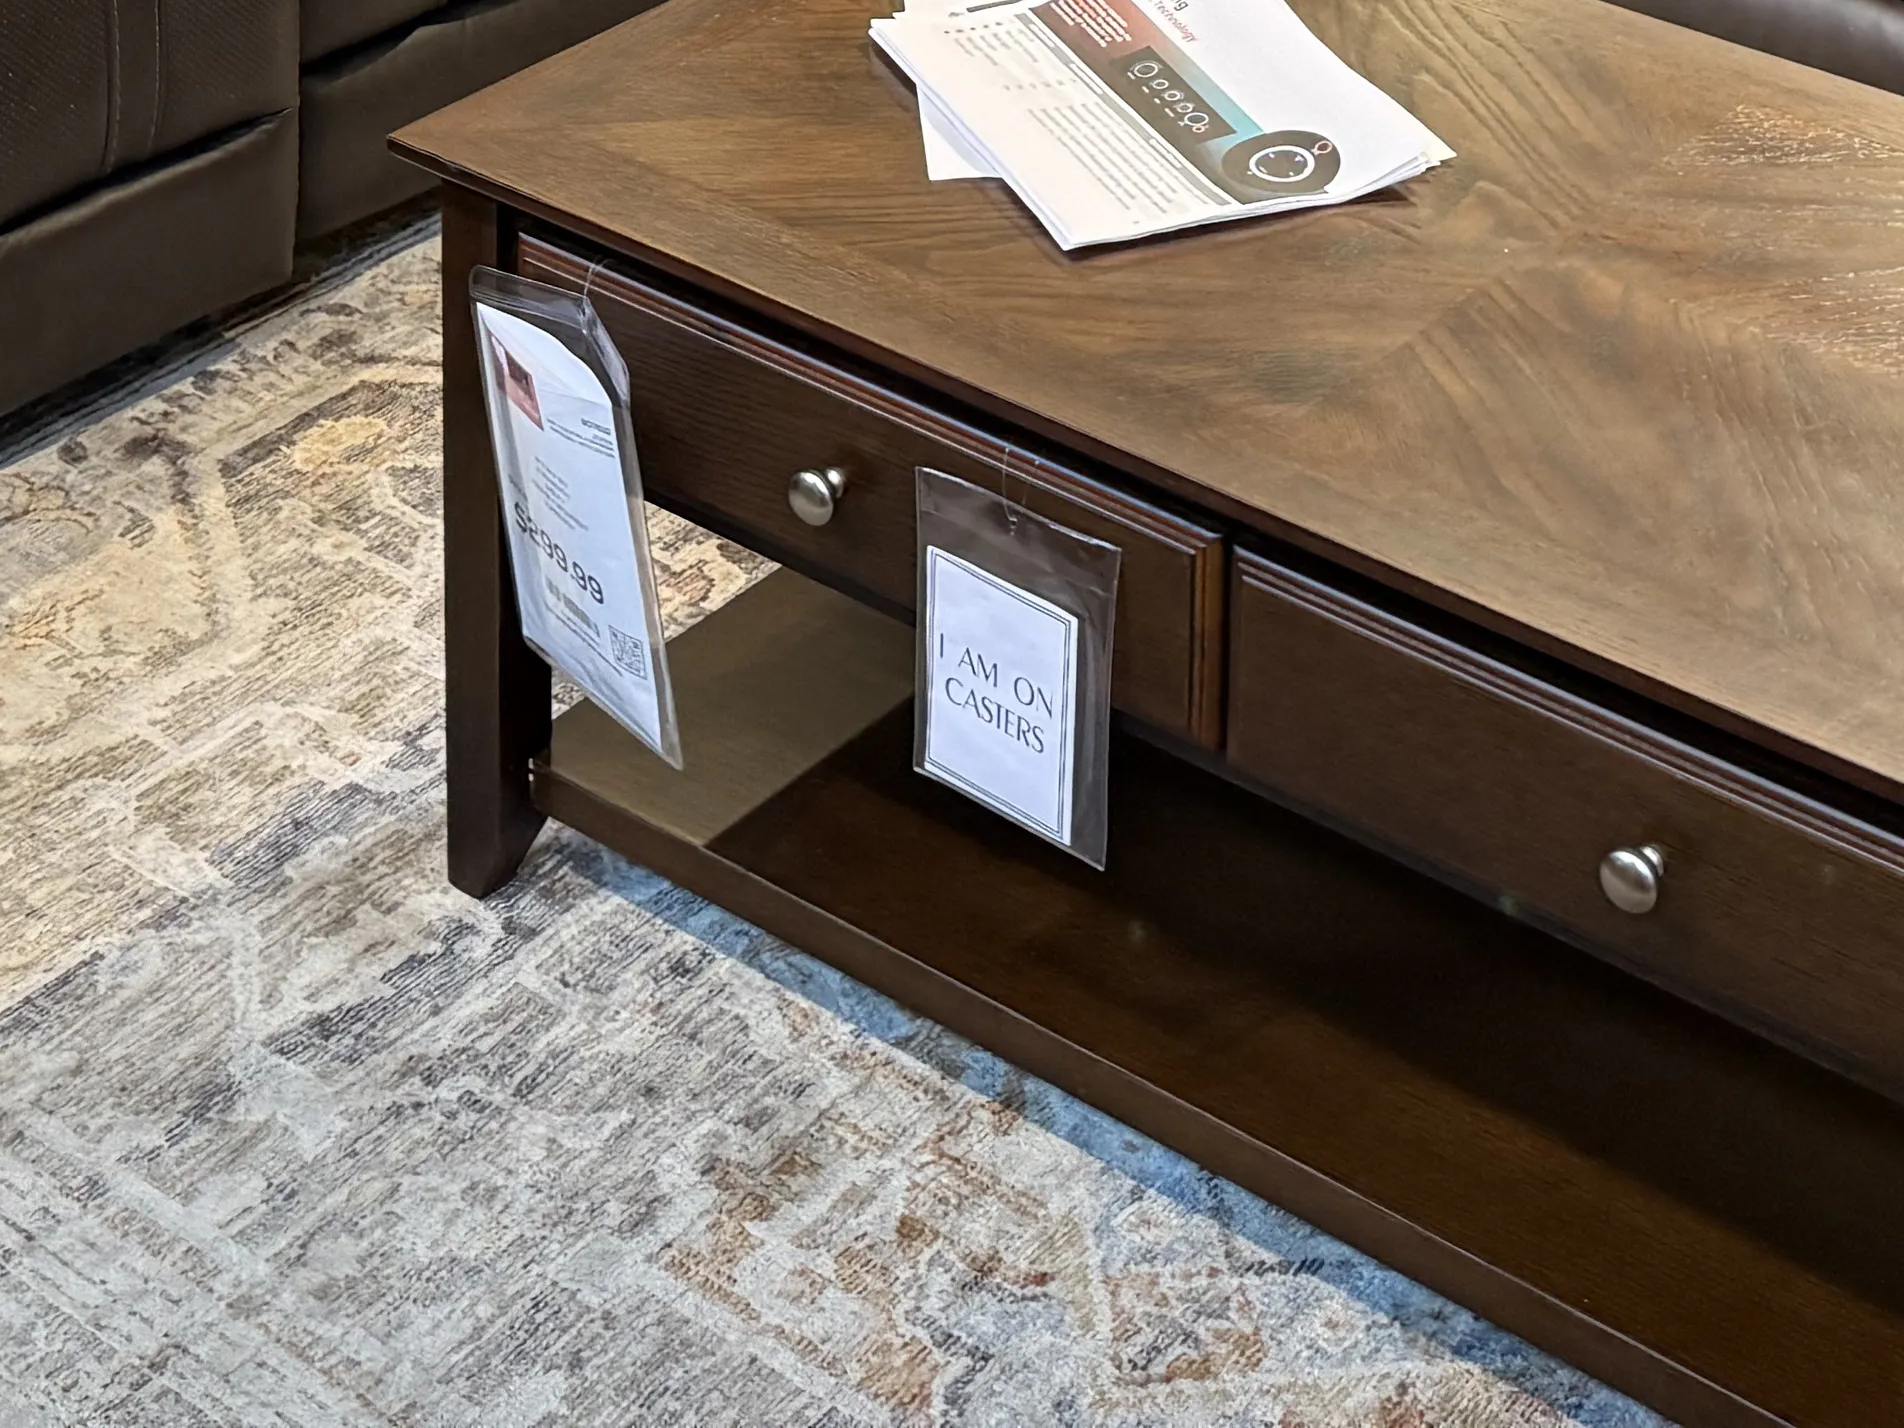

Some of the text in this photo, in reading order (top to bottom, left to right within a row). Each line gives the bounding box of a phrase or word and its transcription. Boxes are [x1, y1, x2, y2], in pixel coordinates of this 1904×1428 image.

[1154, 0, 1199, 42] Technology
[939, 632, 1054, 720] I AM ON
[944, 677, 1045, 755] CASTERS
